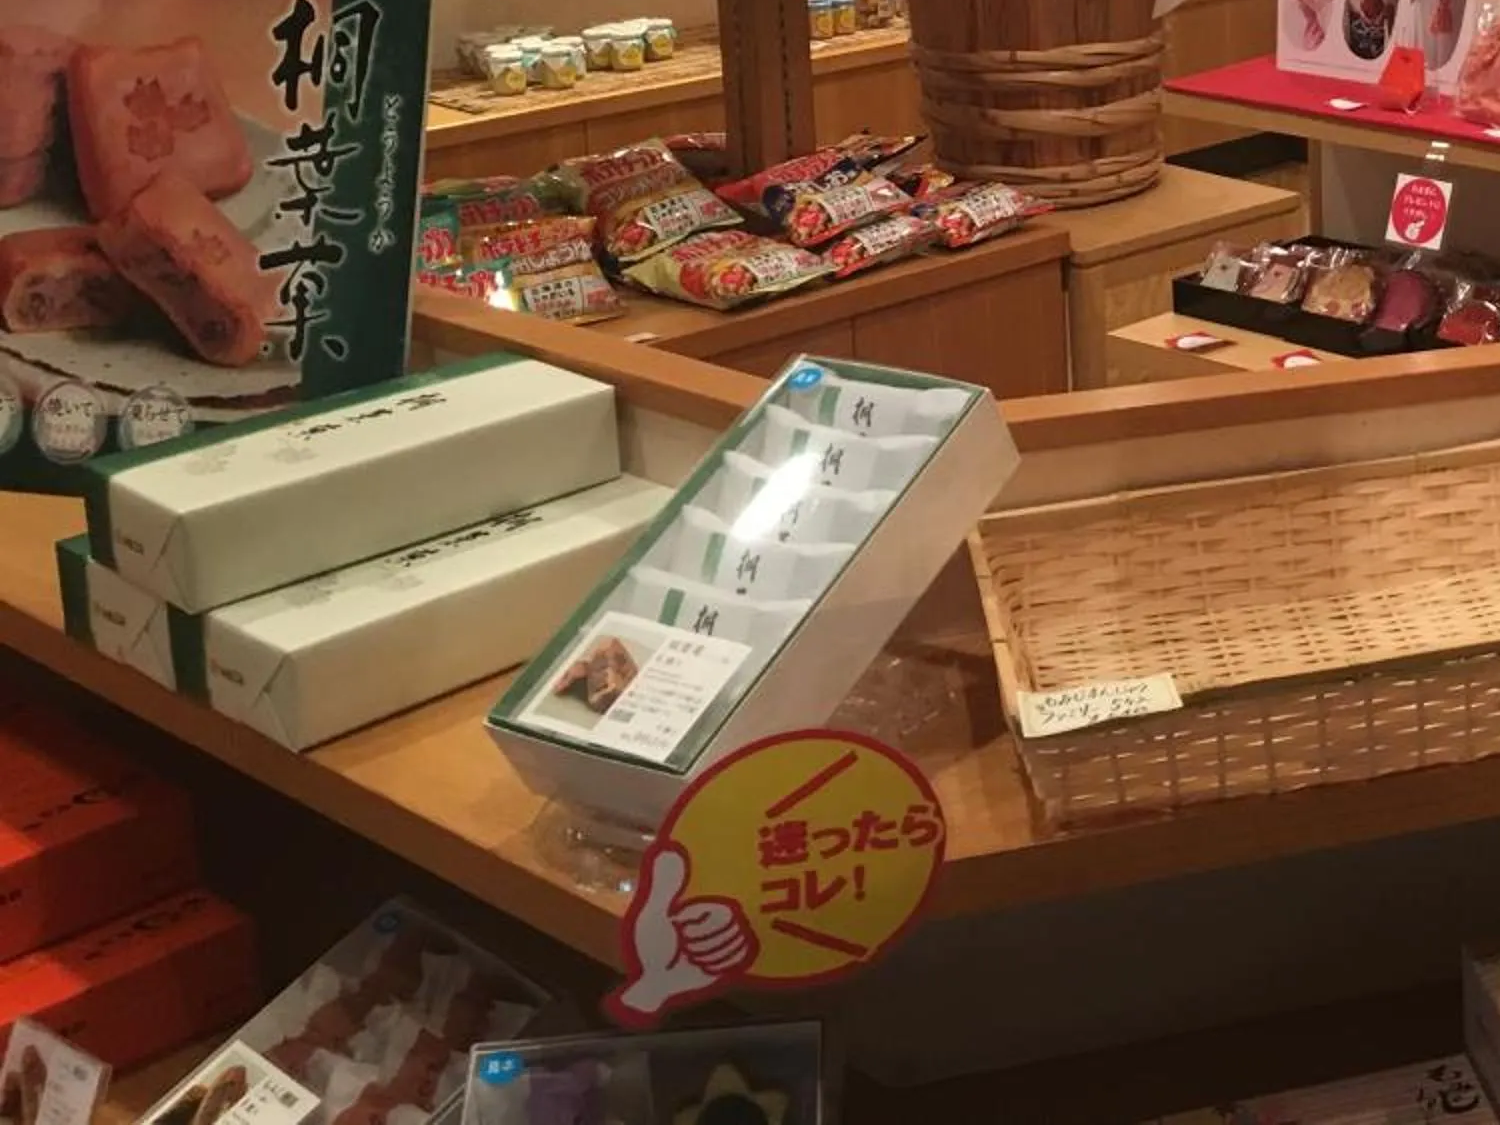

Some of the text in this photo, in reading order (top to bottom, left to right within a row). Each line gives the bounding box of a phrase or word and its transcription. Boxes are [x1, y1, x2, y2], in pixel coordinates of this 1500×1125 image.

[757, 804, 943, 870] 迷ったら
[759, 865, 867, 914] コレ!
